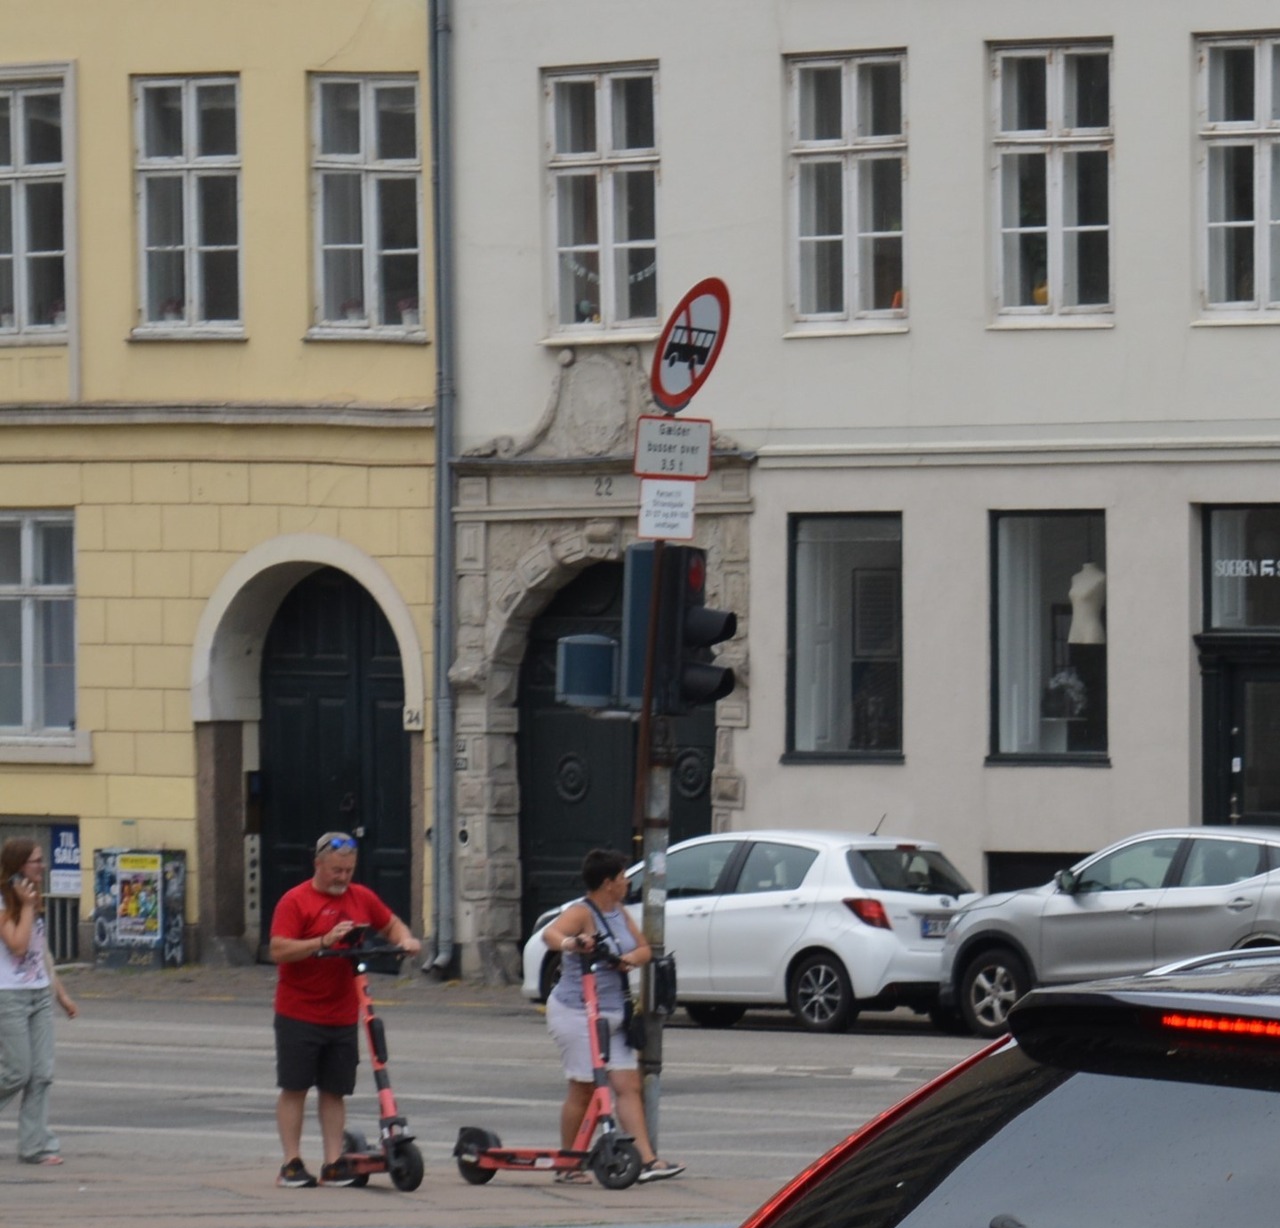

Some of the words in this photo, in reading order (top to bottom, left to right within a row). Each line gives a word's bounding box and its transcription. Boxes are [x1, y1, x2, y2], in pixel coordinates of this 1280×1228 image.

[660, 423, 691, 437] Gælder
[647, 442, 678, 454] busser
[680, 445, 700, 455] over
[594, 476, 613, 497] 22
[1215, 559, 1258, 577] SOEREN
[405, 710, 420, 726] 24
[59, 832, 76, 847] TIL
